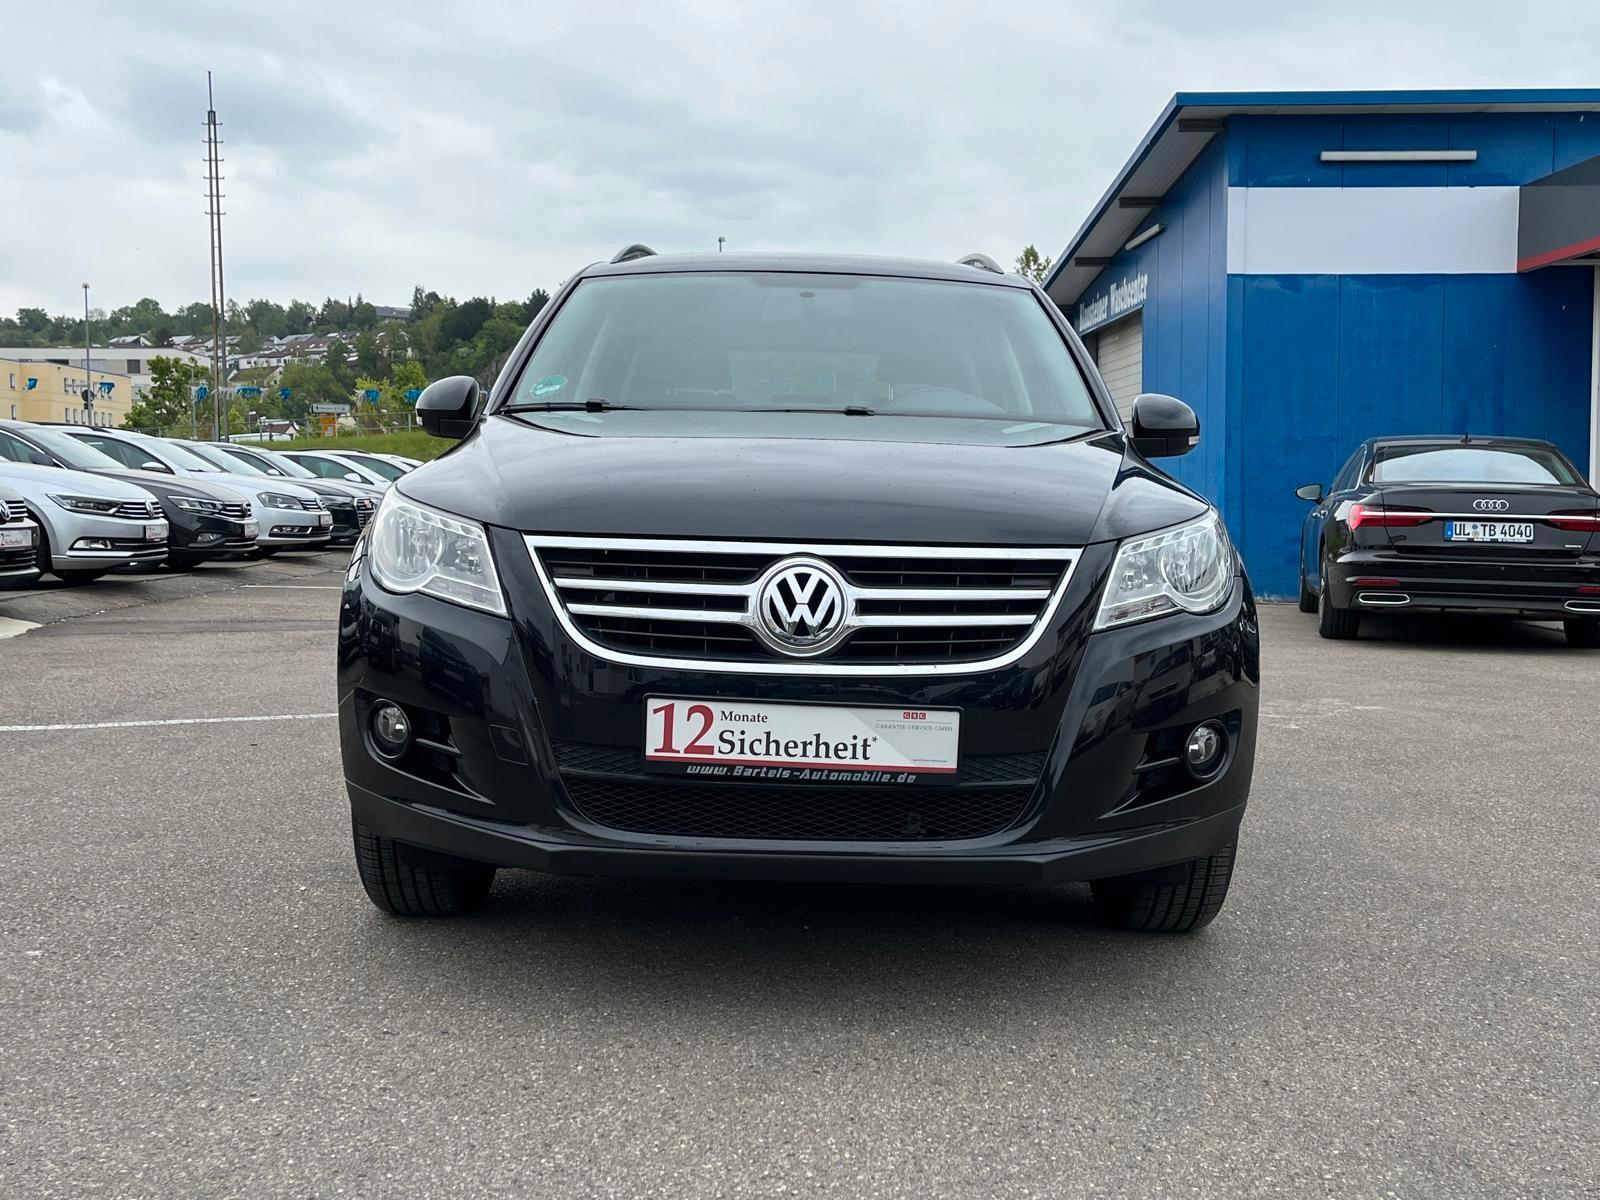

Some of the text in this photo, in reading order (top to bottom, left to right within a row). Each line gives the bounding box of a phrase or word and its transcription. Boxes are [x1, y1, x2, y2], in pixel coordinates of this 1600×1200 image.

[1110, 272, 1148, 316] Waschcenter
[1454, 523, 1533, 538] UL TB 4040
[720, 710, 768, 723] Monate
[903, 711, 927, 720] GSG
[652, 702, 715, 756] 12
[686, 765, 917, 784] www.Bartels-Automobile.de
